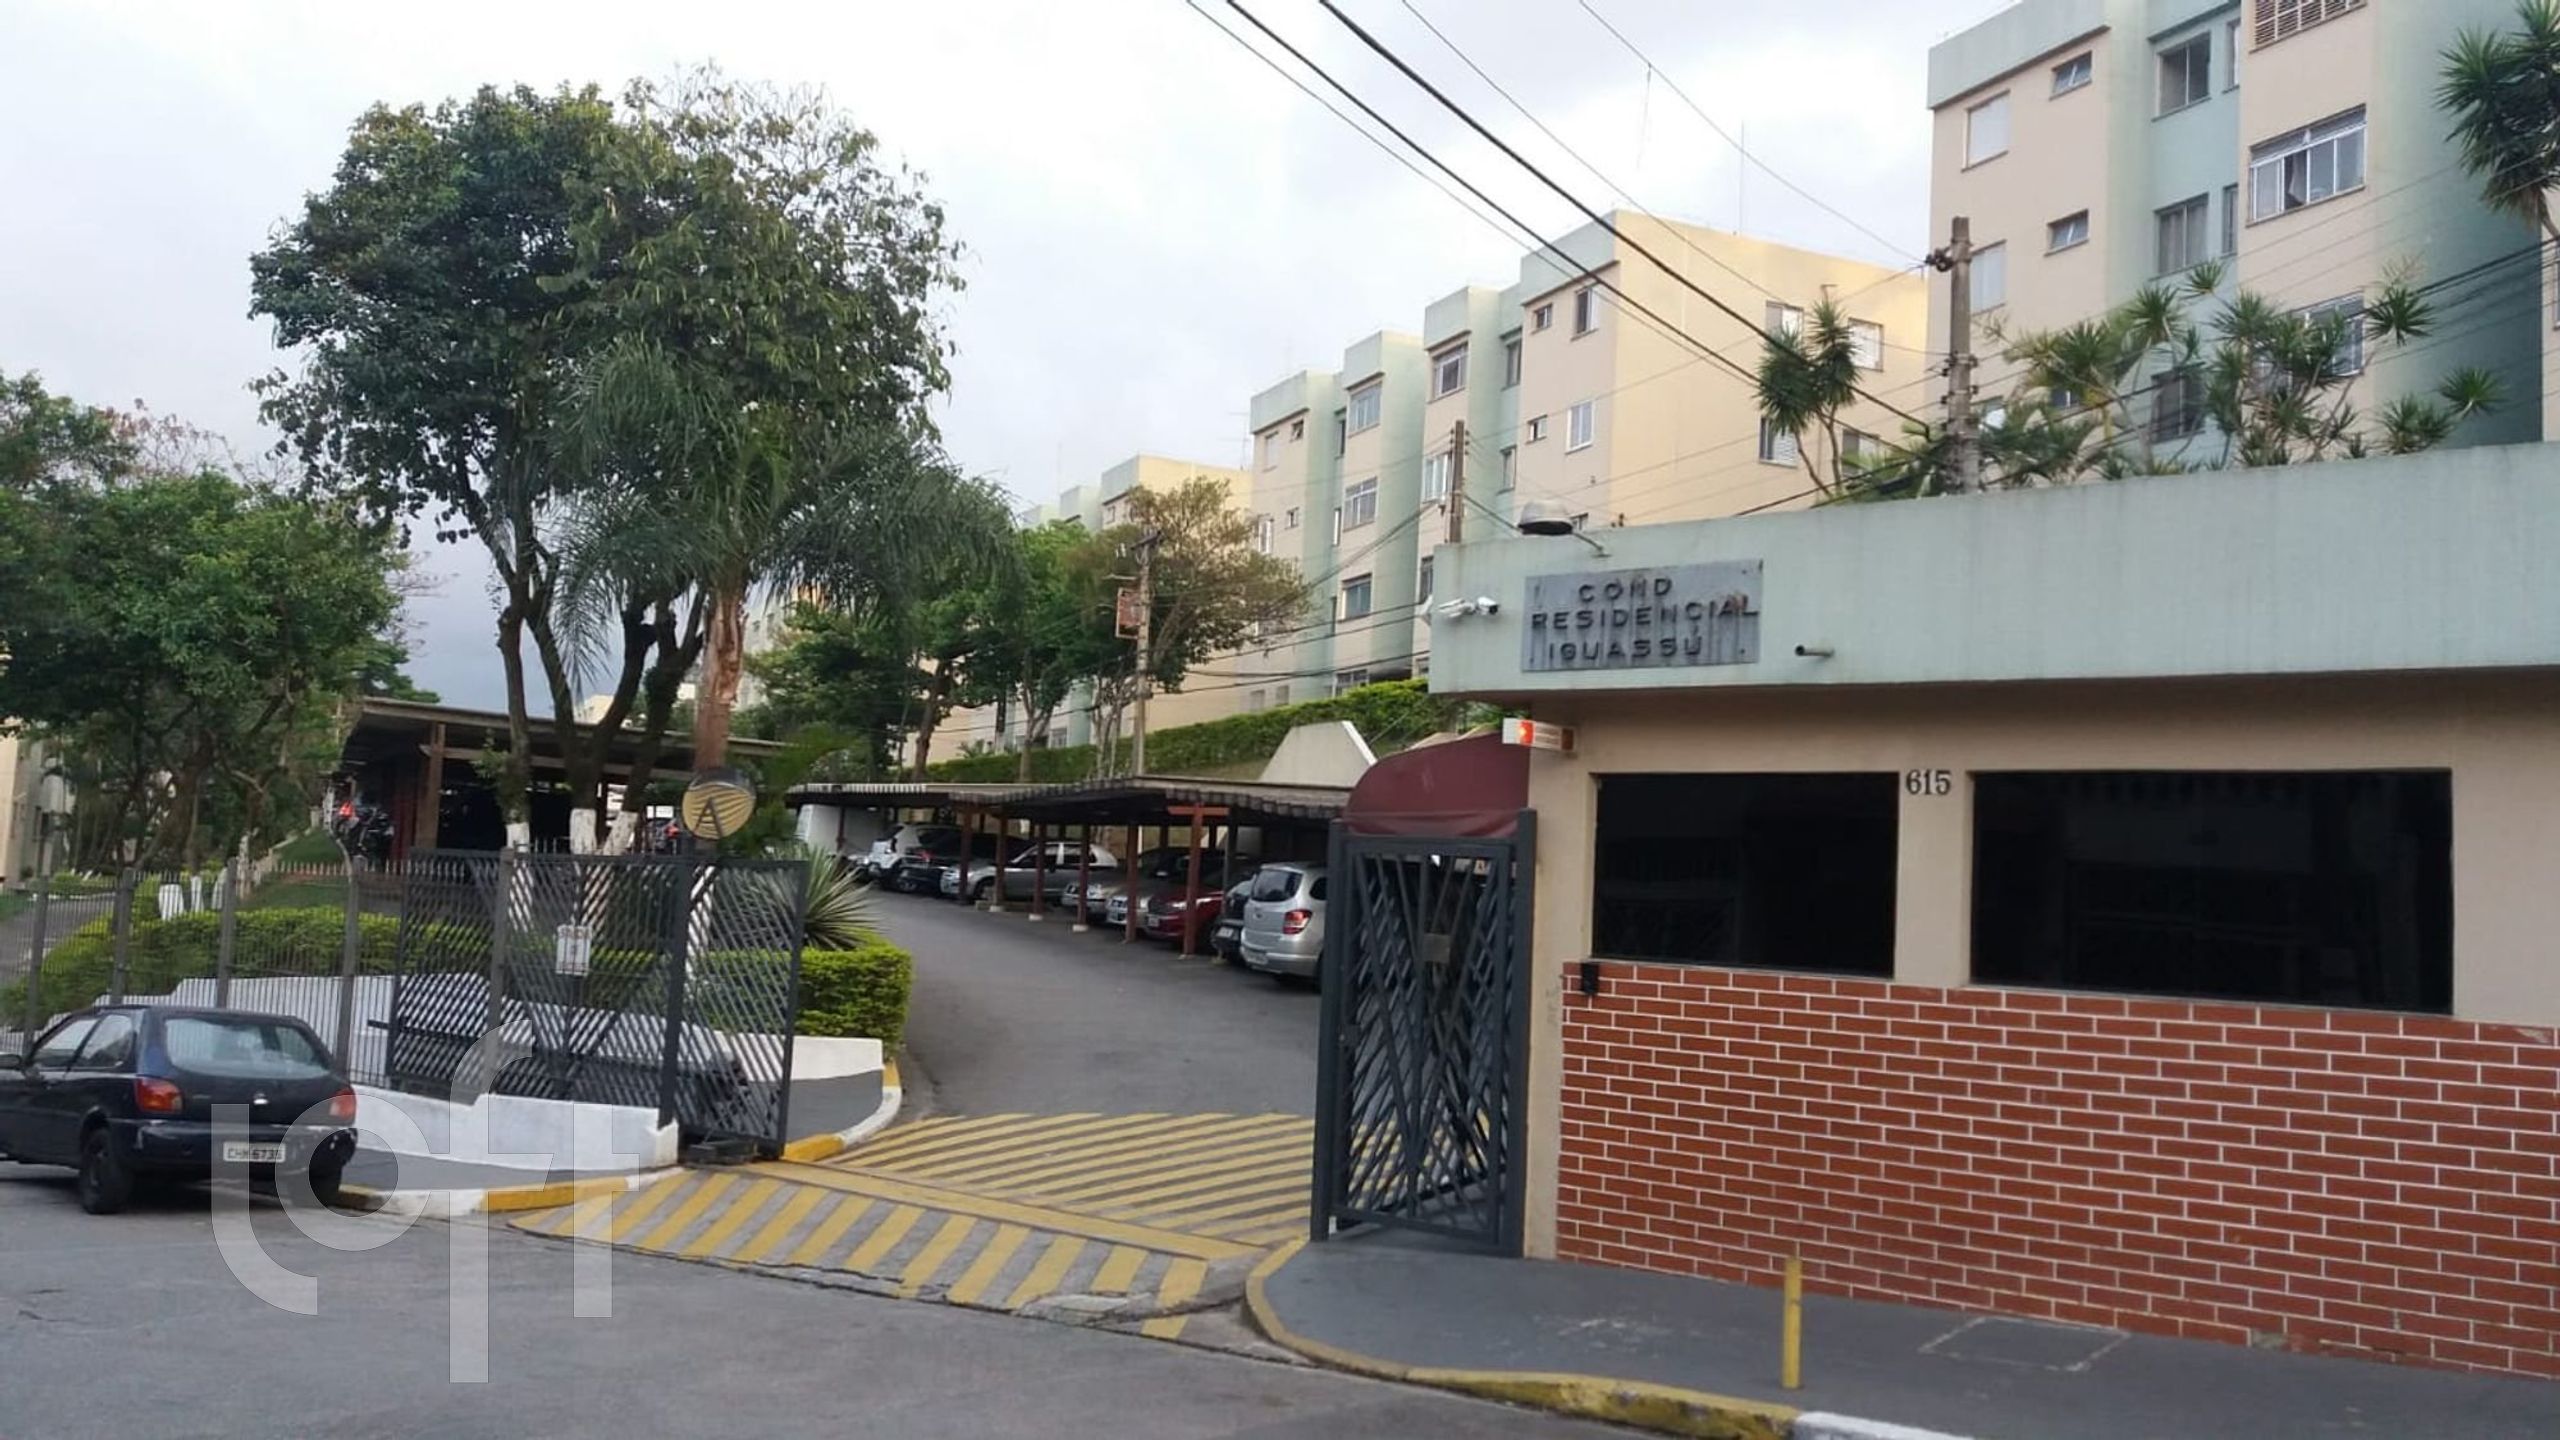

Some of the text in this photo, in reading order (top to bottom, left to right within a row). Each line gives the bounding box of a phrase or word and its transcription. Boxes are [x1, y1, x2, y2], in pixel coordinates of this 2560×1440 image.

[1579, 578, 1673, 602] COND
[1531, 595, 1759, 630] RESIDENCIAL
[1906, 769, 1951, 795] 615
